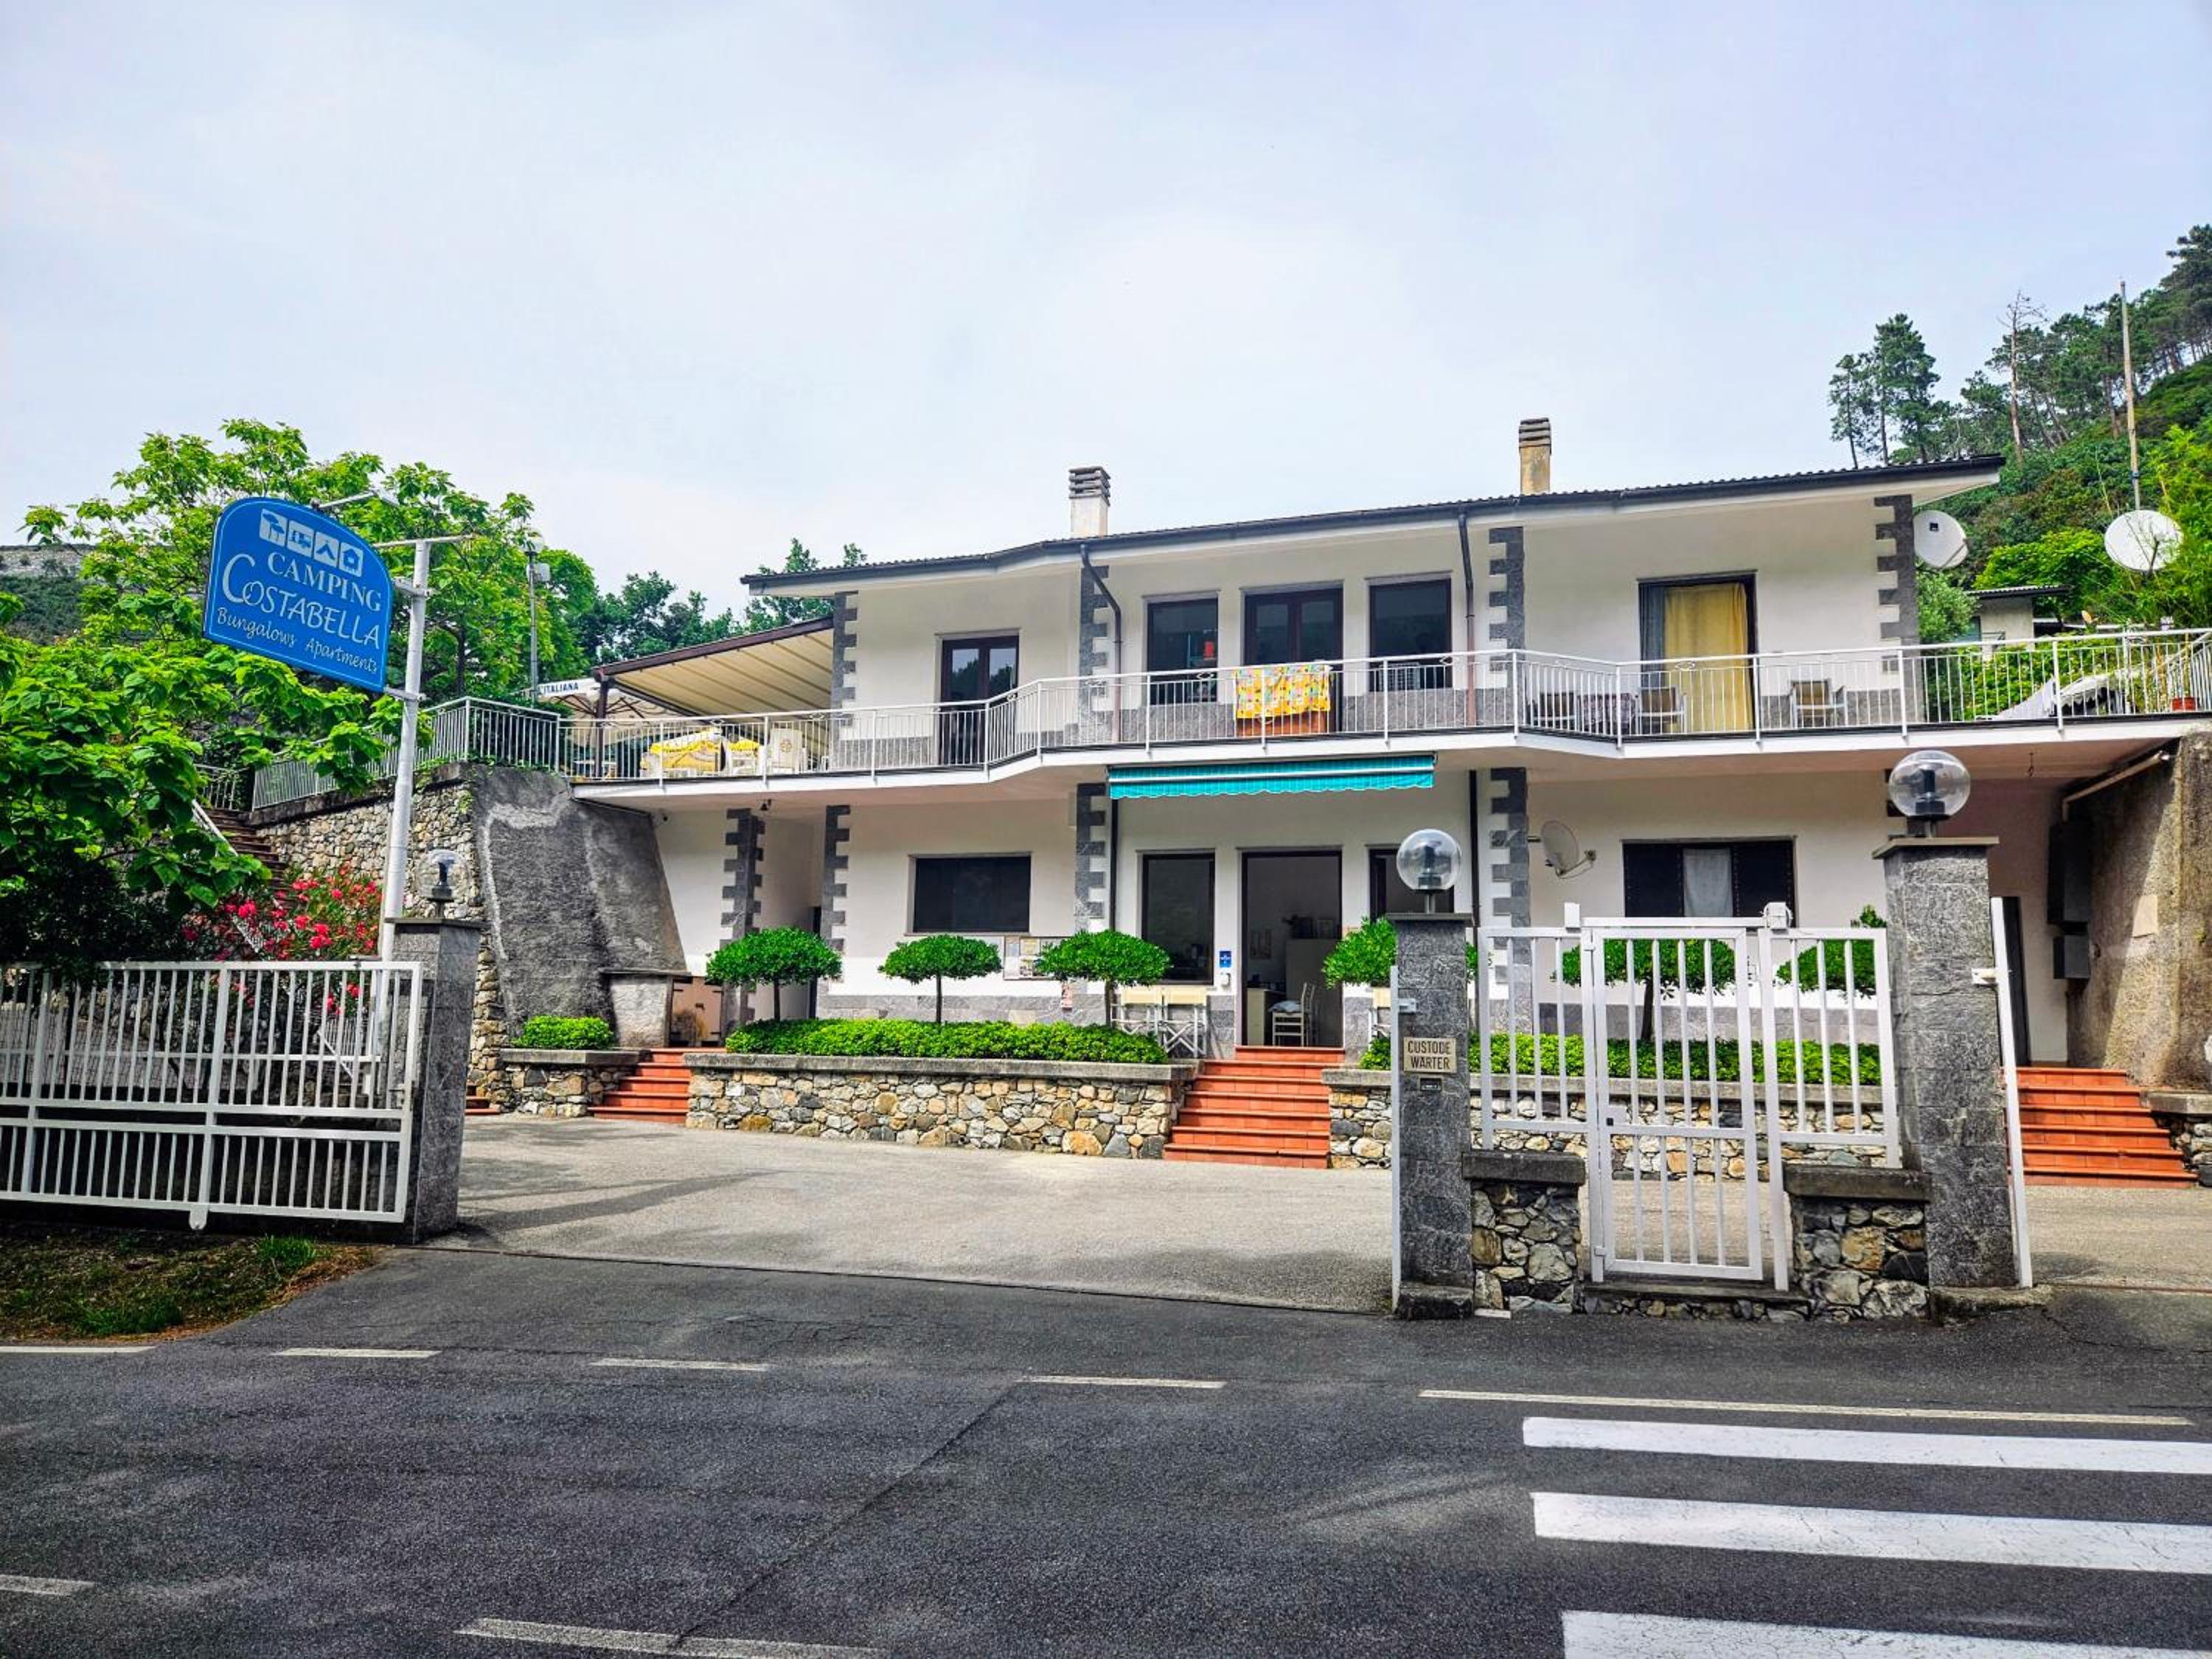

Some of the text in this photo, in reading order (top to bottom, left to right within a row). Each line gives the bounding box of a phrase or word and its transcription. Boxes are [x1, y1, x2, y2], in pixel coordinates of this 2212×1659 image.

[267, 552, 382, 612] CAMPING
[217, 607, 378, 674] Bungalows Apartments
[1408, 1040, 1451, 1054] CUSTODE
